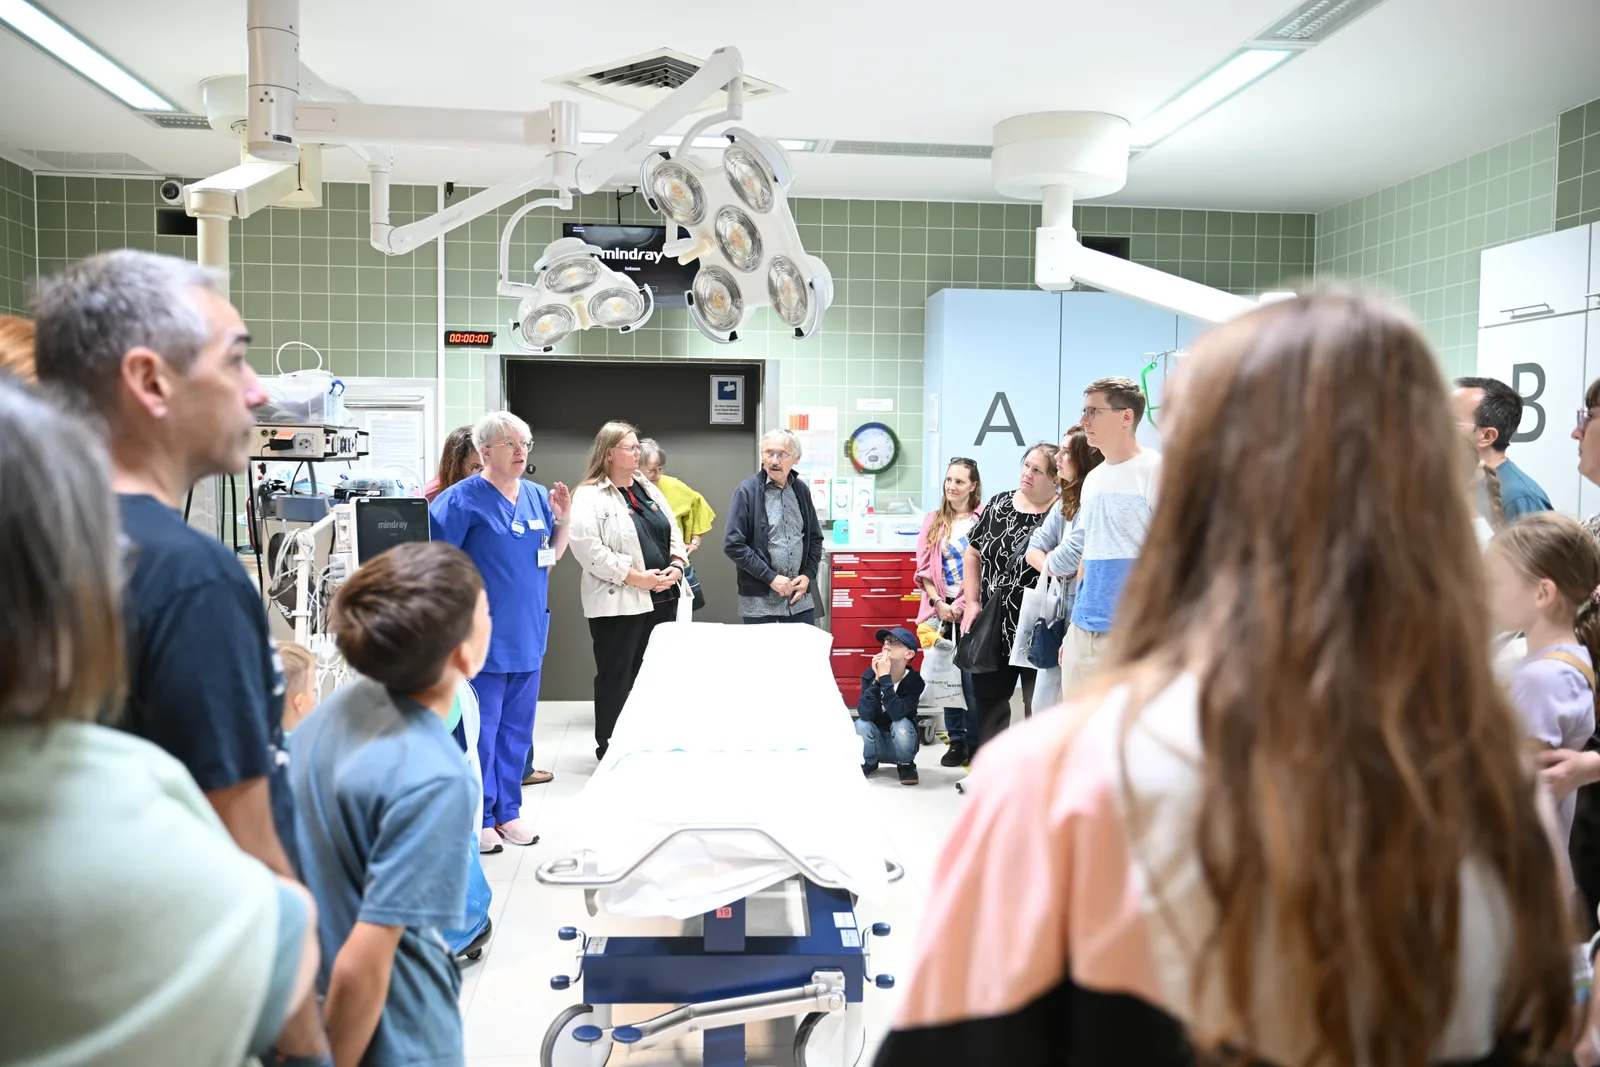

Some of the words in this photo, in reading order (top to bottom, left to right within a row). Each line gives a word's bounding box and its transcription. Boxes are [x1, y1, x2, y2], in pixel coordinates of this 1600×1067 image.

[601, 247, 663, 264] mindray
[449, 333, 489, 343] 00:00:00
[1509, 362, 1546, 443] B
[973, 391, 1026, 446] A
[378, 521, 408, 531] mindray
[719, 908, 730, 917] 19
